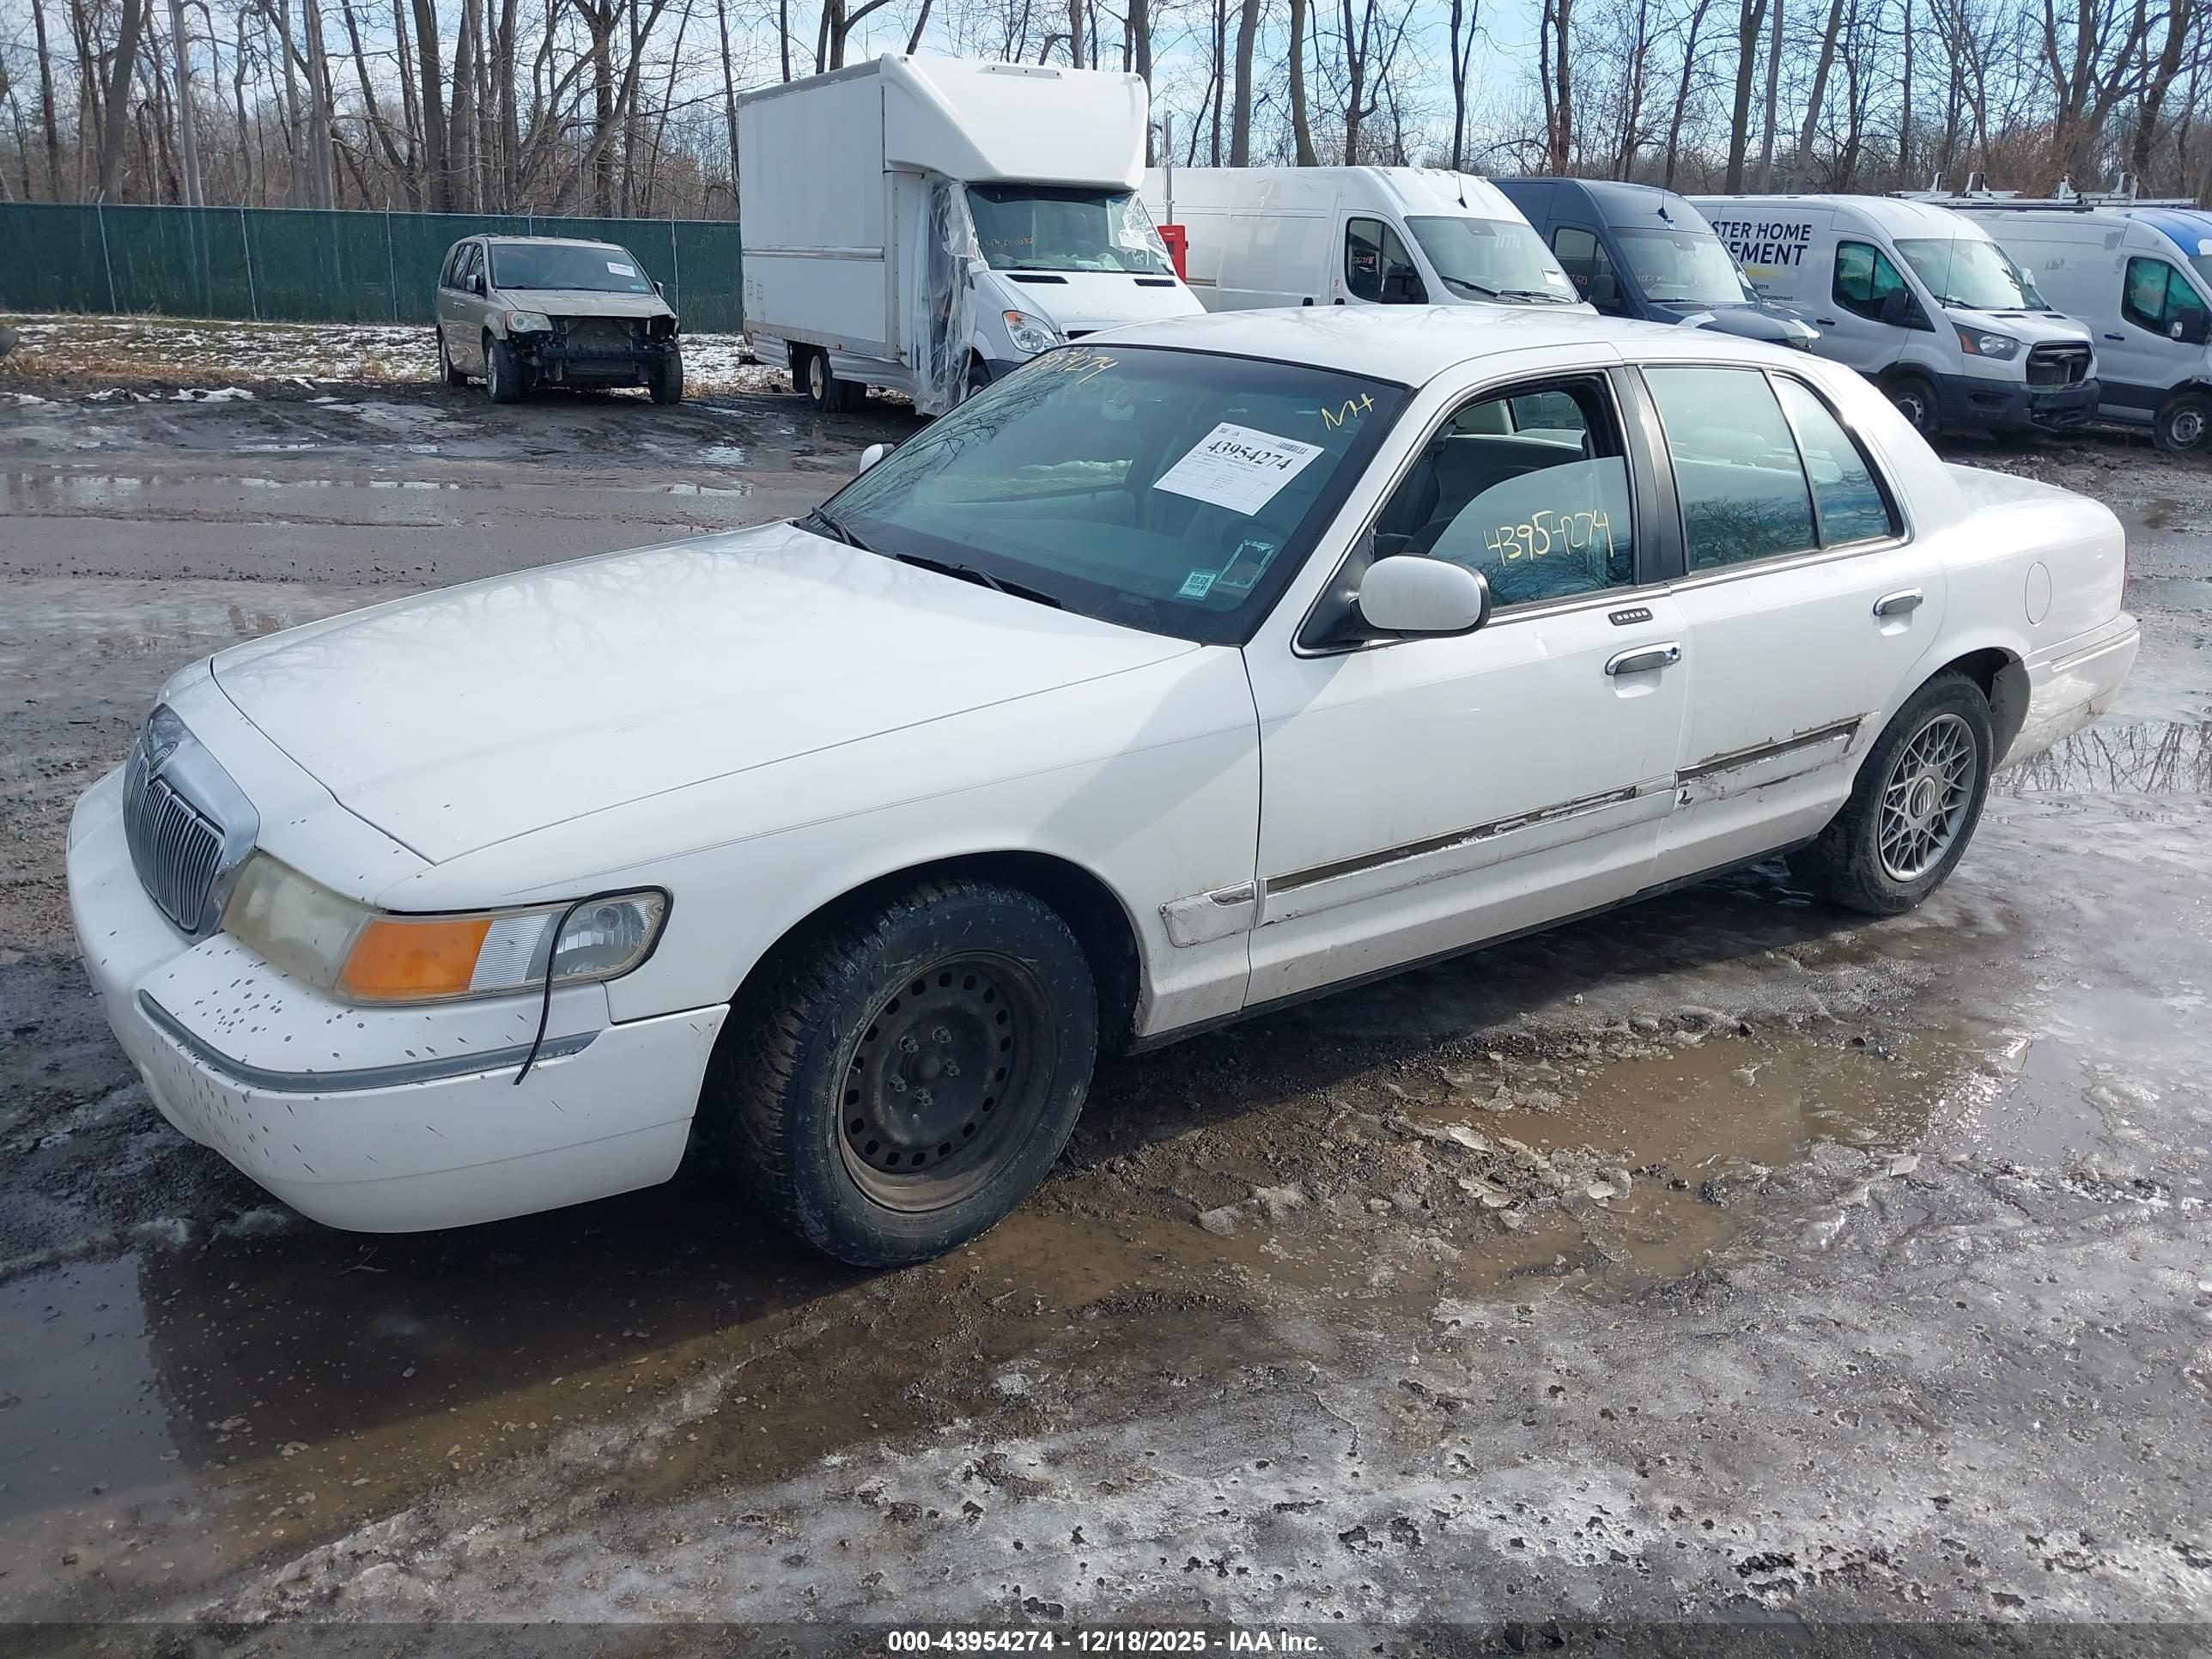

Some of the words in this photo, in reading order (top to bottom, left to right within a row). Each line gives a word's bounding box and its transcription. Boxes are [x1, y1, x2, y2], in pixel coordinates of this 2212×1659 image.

[1709, 221, 1752, 239] STER
[1756, 222, 1813, 241] HOME
[1723, 240, 1808, 266] EMENT
[1207, 440, 1293, 471] 43954274
[1483, 509, 1614, 567] 43954274
